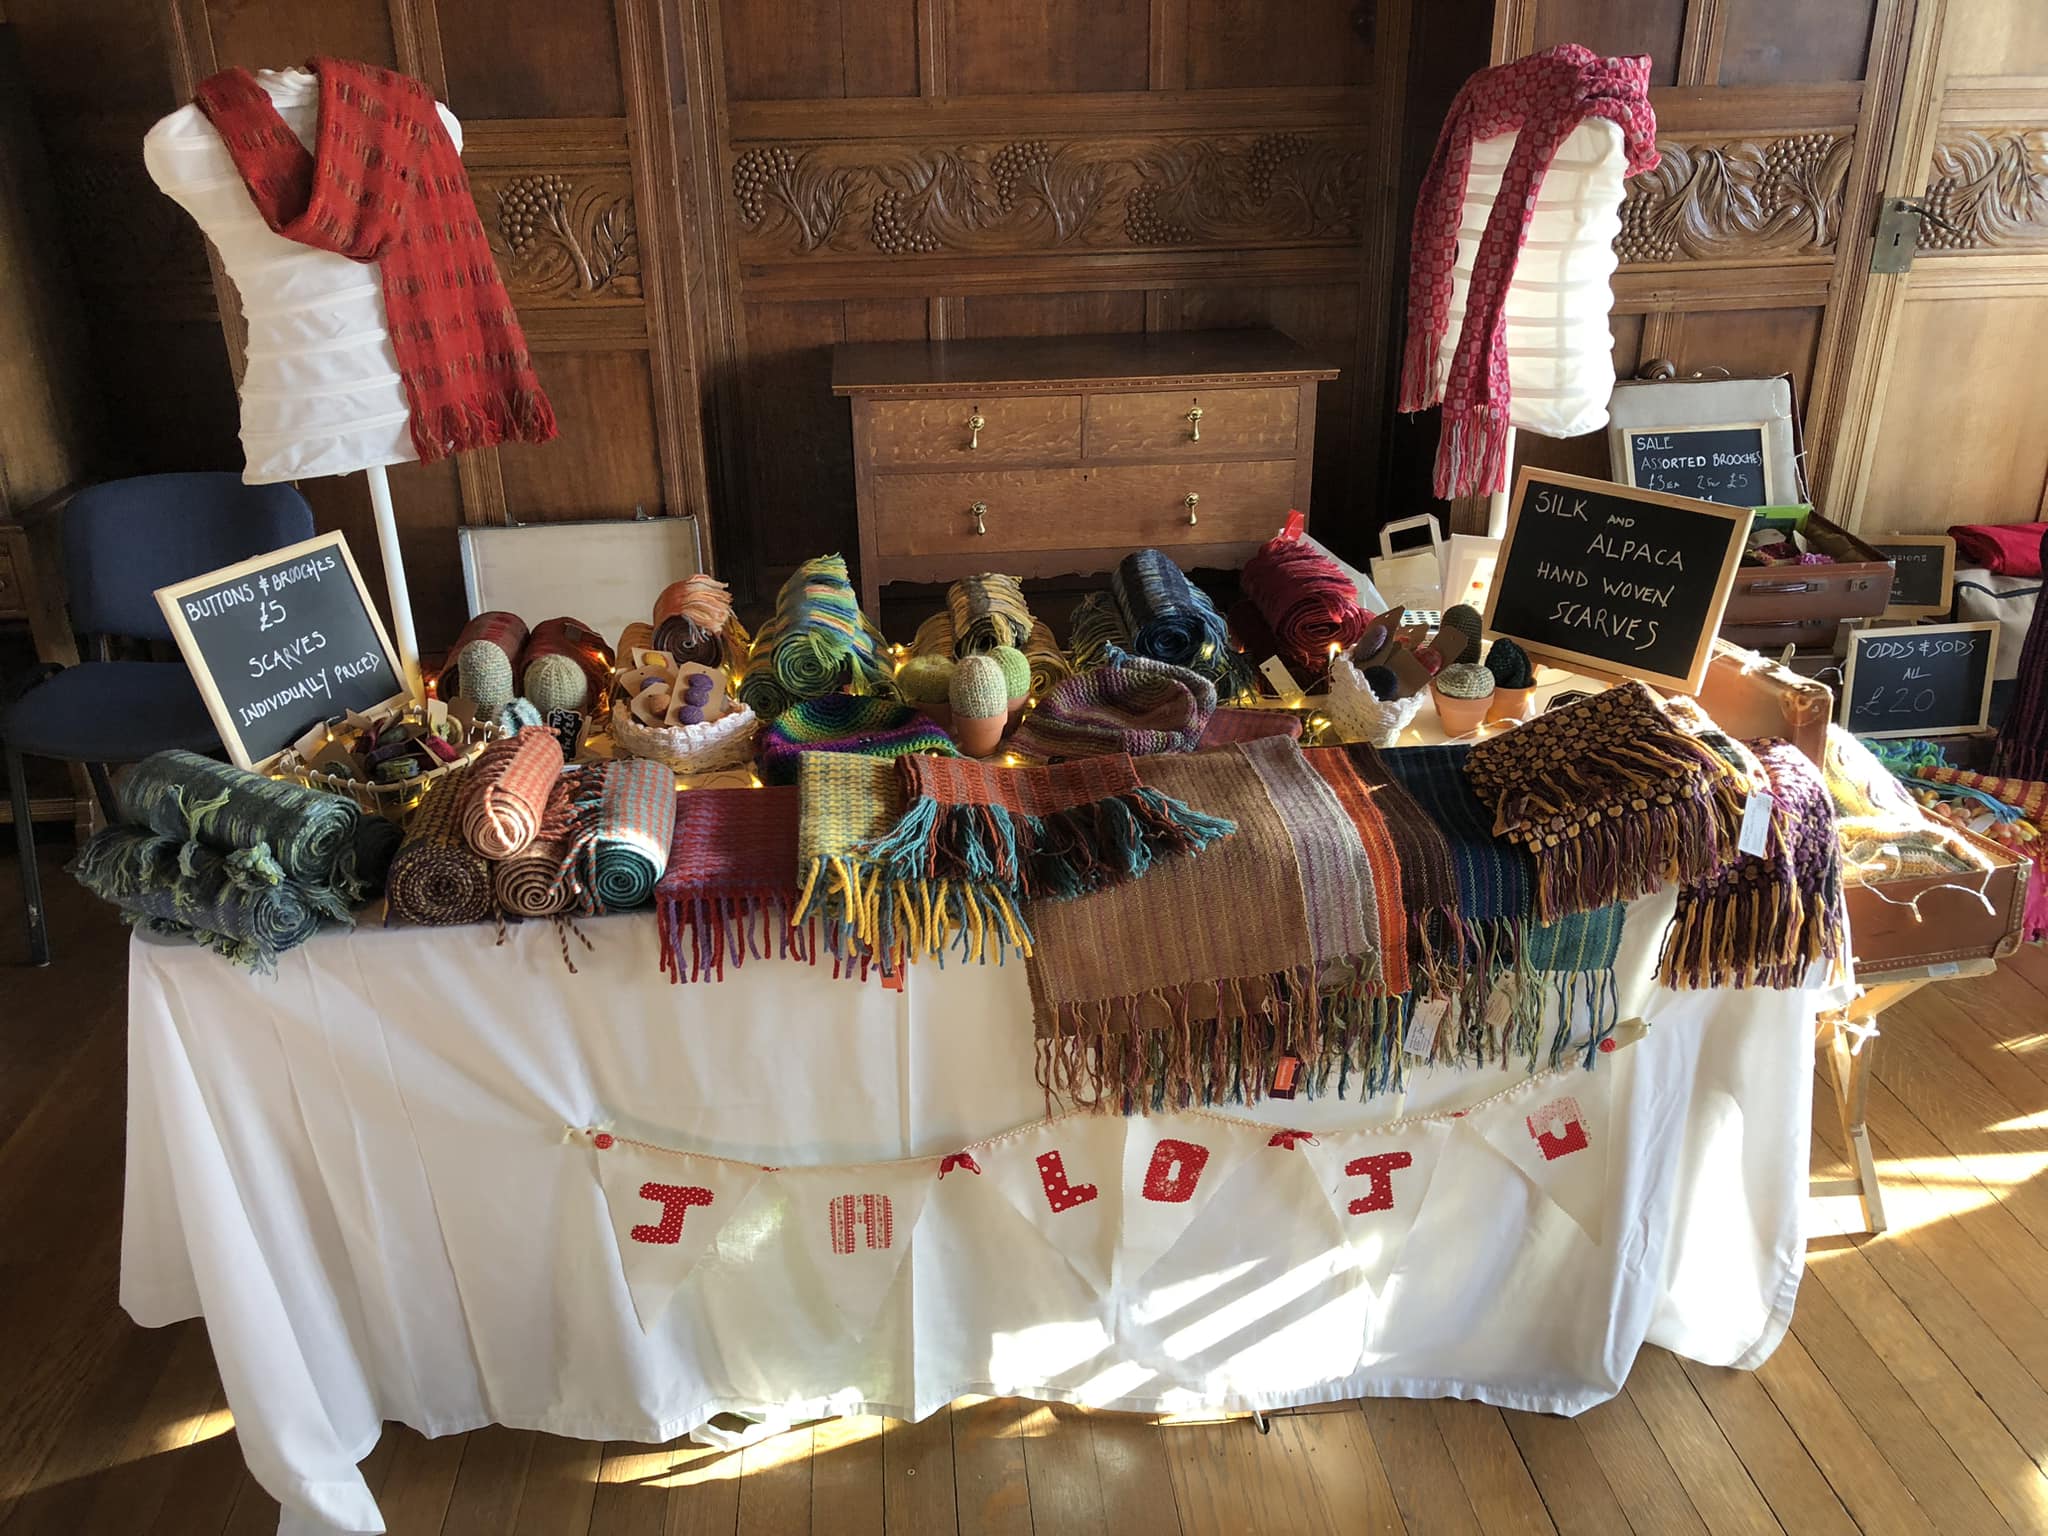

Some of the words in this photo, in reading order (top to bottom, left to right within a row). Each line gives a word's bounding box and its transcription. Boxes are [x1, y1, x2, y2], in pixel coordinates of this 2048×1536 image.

[1637, 437, 1673, 451] SALE
[1640, 456, 1707, 472] ASSORTED
[1712, 451, 1762, 467] BROOCHES
[1535, 491, 1588, 522] SILK
[1607, 514, 1636, 528] AND
[1586, 533, 1685, 572] ALPACA
[185, 583, 255, 622] BUTTONS
[271, 556, 336, 592] BROOCHES
[1536, 561, 1589, 588] HAND
[1602, 577, 1675, 608] WOVEN
[259, 600, 287, 631] £5
[1549, 601, 1660, 651] SCARVES
[249, 631, 327, 678] SCARVES
[1866, 641, 1915, 659] ODDS
[1927, 639, 1977, 658] SODS
[238, 668, 333, 728] INDIVIDUALLY
[334, 651, 380, 685] PRICED
[1902, 667, 1932, 681] ALL
